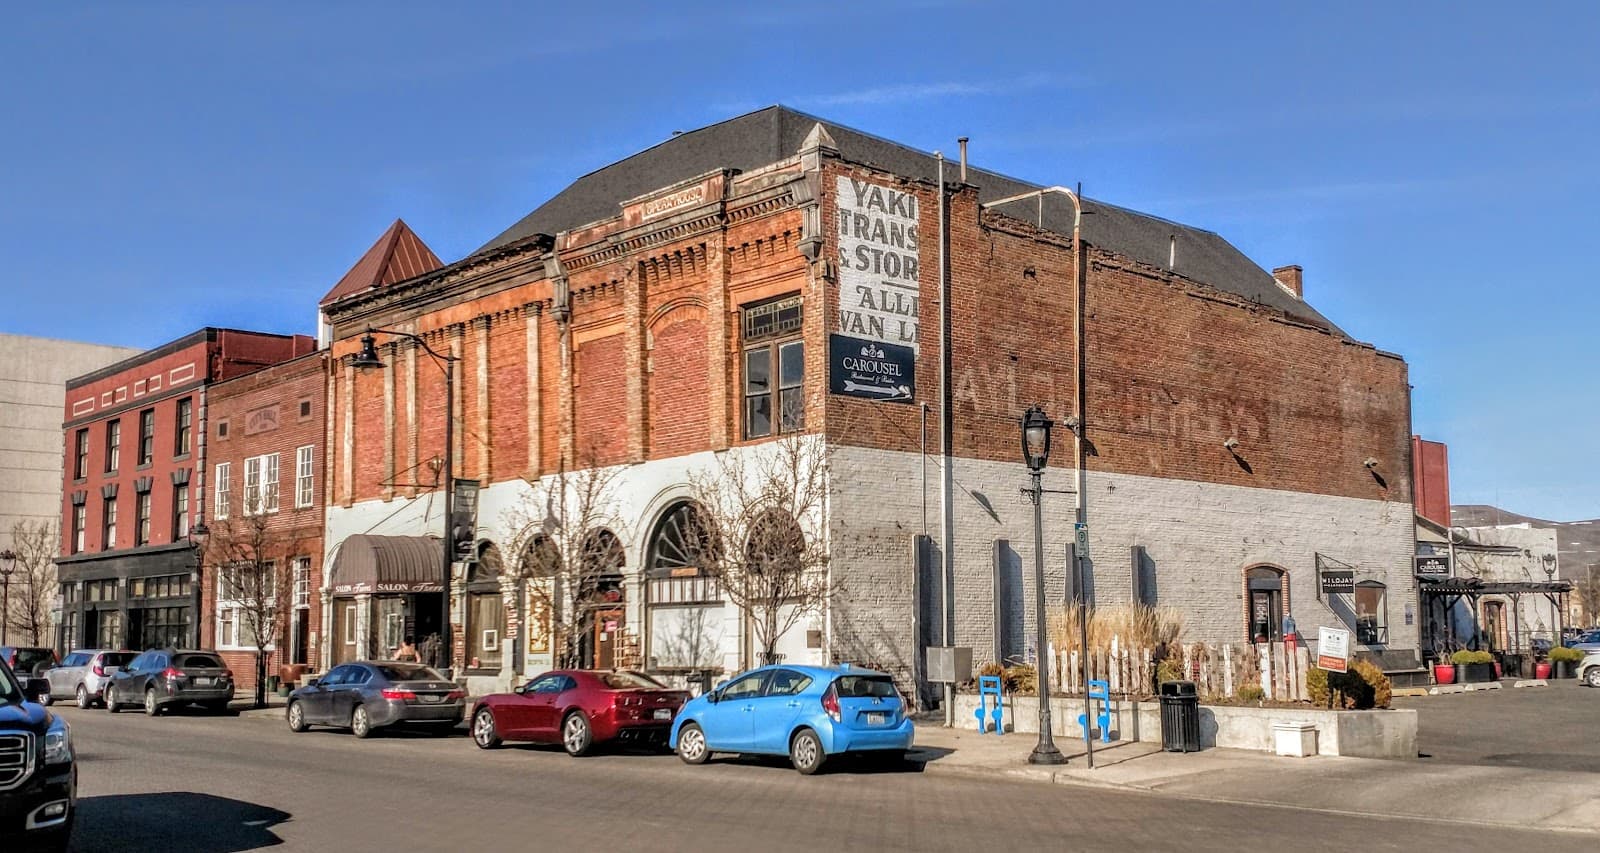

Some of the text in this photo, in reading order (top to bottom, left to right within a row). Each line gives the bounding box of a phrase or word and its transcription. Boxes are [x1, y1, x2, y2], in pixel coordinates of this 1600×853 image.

[674, 187, 702, 206] HOUSE
[850, 178, 915, 220] YAKI
[839, 207, 919, 251] TRANS
[855, 244, 919, 280] STOR
[839, 309, 885, 340] VAN
[843, 357, 902, 377] CAROUSEL
[335, 584, 352, 593] SALON
[377, 583, 408, 592] SALON
